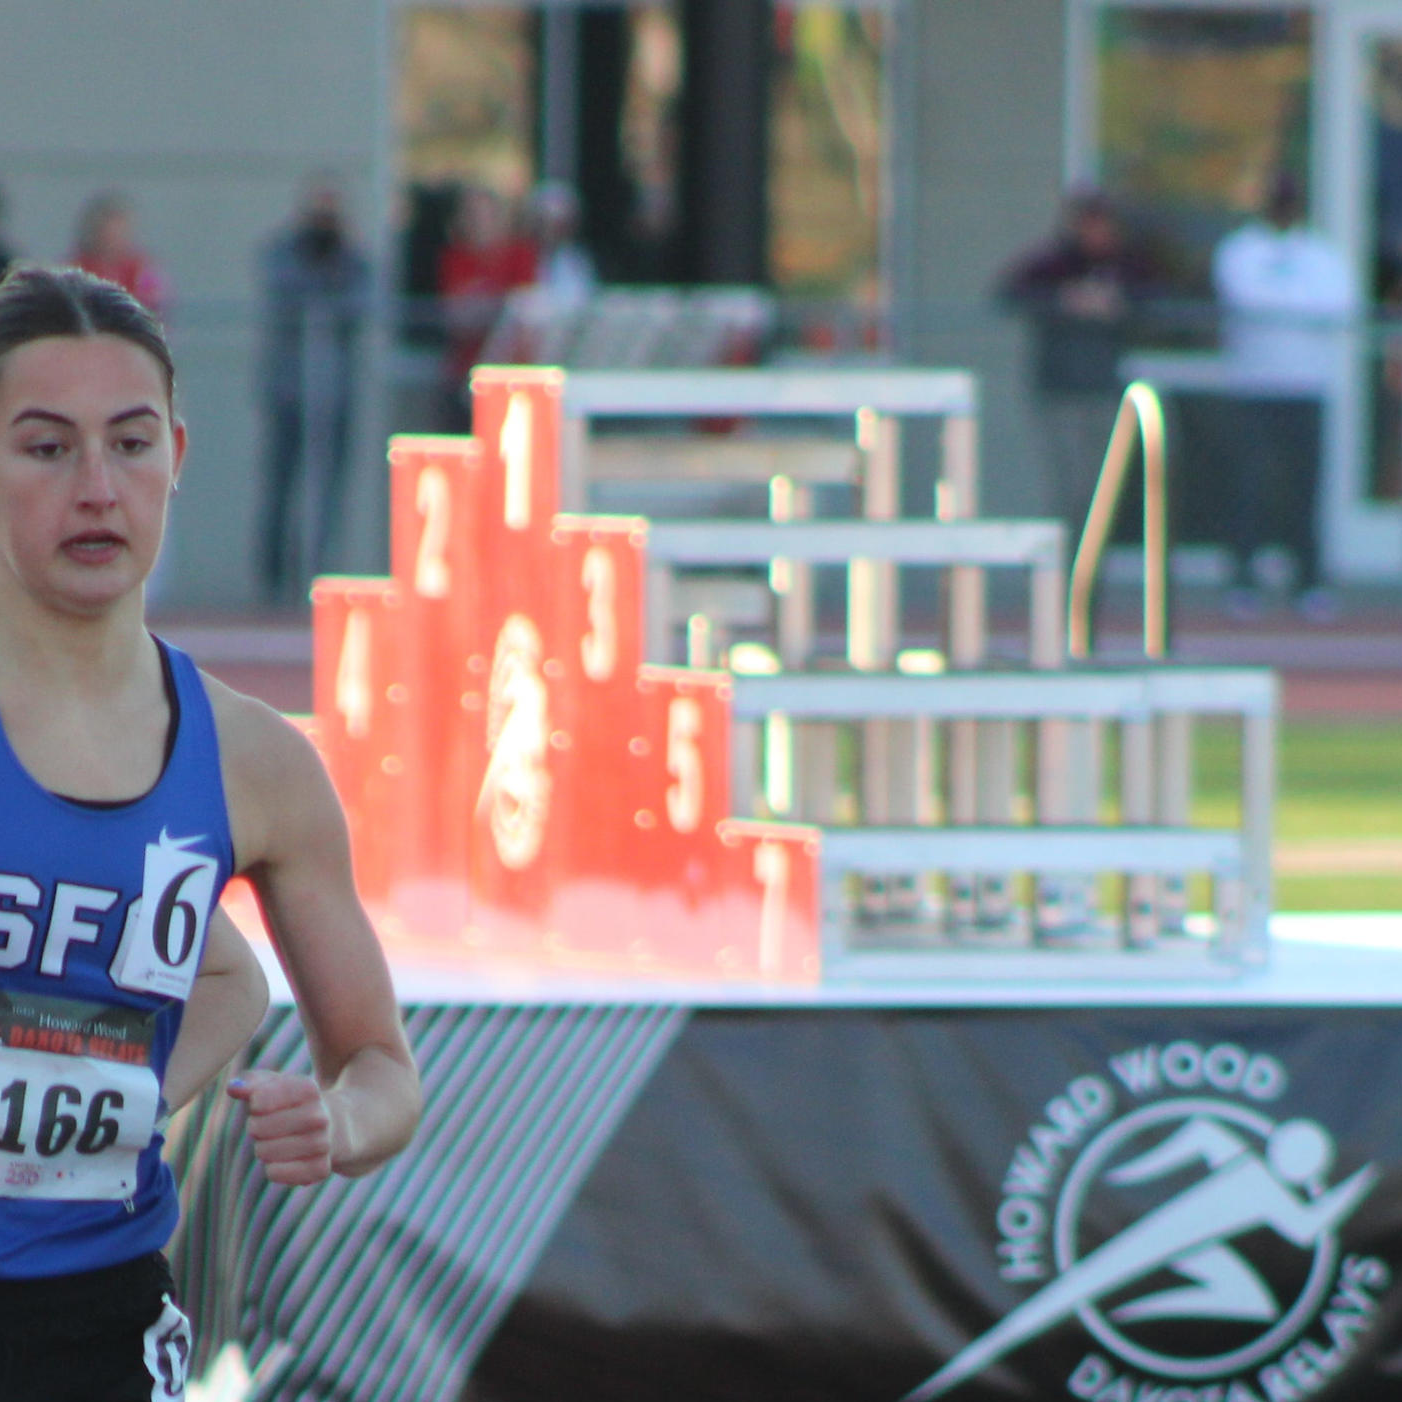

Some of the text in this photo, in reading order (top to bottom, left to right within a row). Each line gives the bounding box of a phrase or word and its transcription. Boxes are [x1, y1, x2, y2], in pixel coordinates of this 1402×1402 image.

[499, 391, 532, 531] 1
[414, 464, 450, 598] 2
[581, 545, 617, 682] 3
[666, 697, 704, 834] 5
[152, 864, 210, 968] 6
[38, 1013, 92, 1033] Howard
[93, 1023, 128, 1040] Wood
[998, 1041, 1286, 1281] HOWARD WOOD
